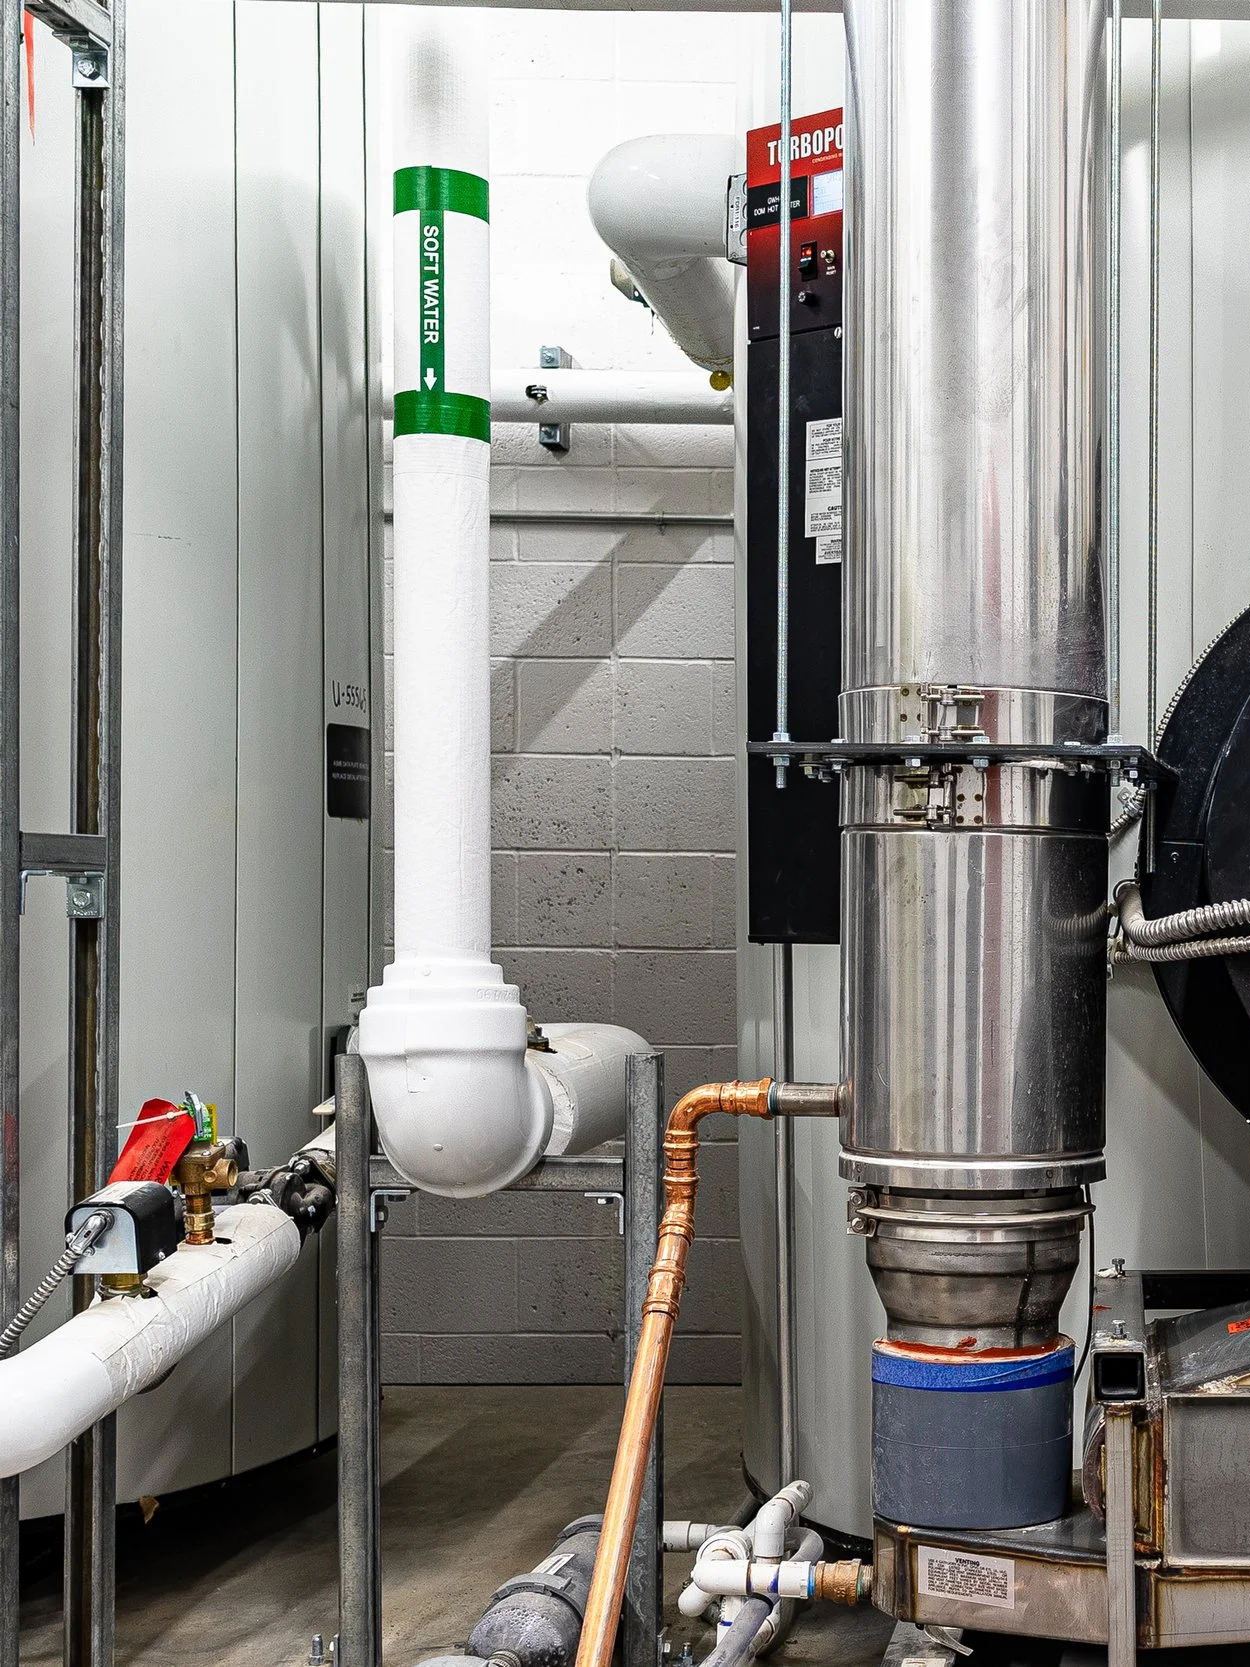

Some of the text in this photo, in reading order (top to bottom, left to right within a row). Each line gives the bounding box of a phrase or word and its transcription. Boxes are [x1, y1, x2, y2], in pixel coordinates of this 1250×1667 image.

[767, 204, 779, 213] HOT
[423, 225, 440, 344] SOFT WATER
[955, 1558, 979, 1566] VENTING
